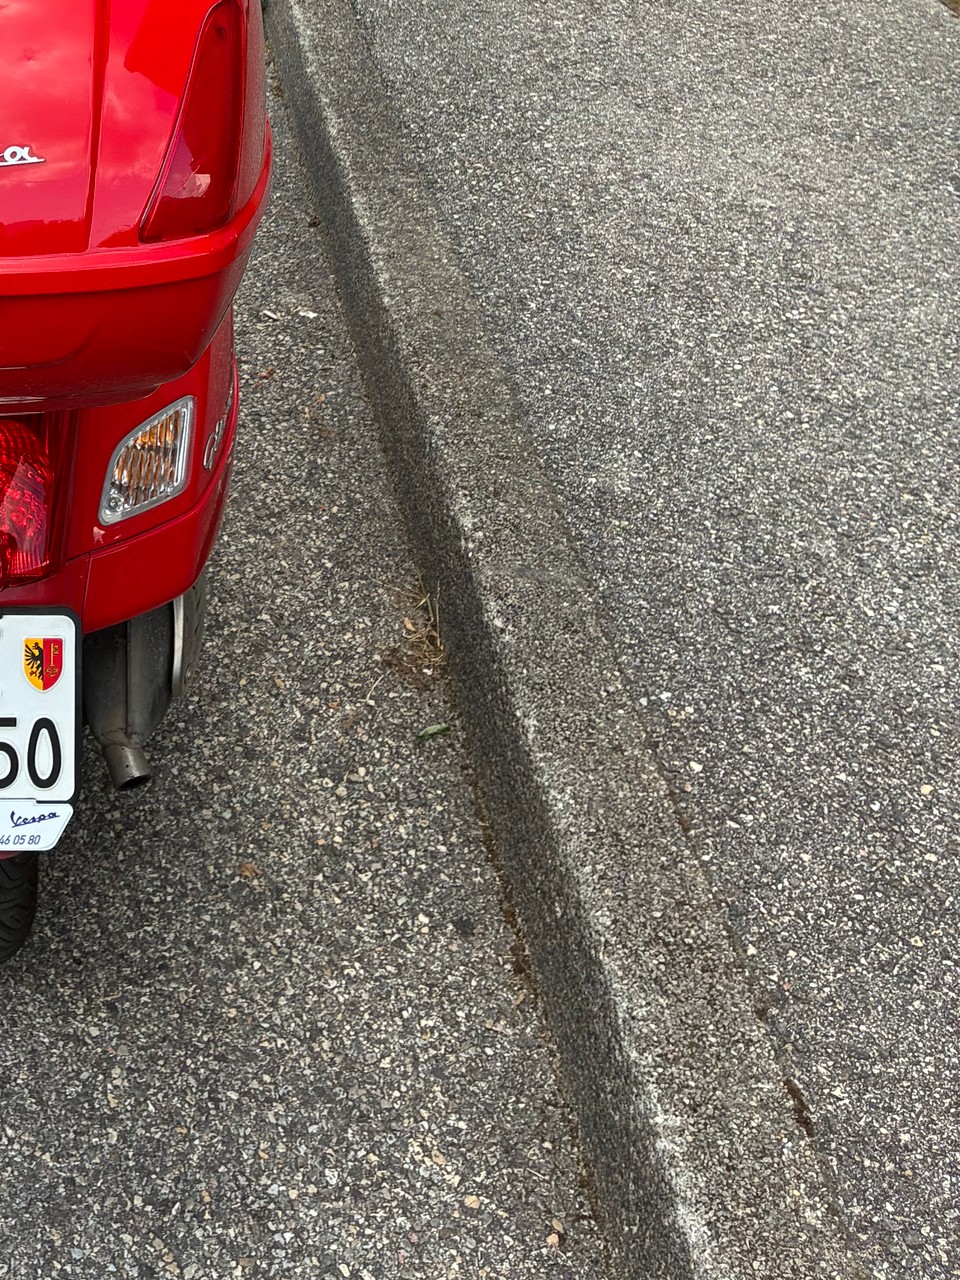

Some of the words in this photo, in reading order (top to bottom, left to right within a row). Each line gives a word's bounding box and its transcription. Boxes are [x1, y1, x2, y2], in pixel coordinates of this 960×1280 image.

[10, 810, 60, 828] Vespa
[13, 835, 26, 845] 05
[28, 835, 41, 845] 80
